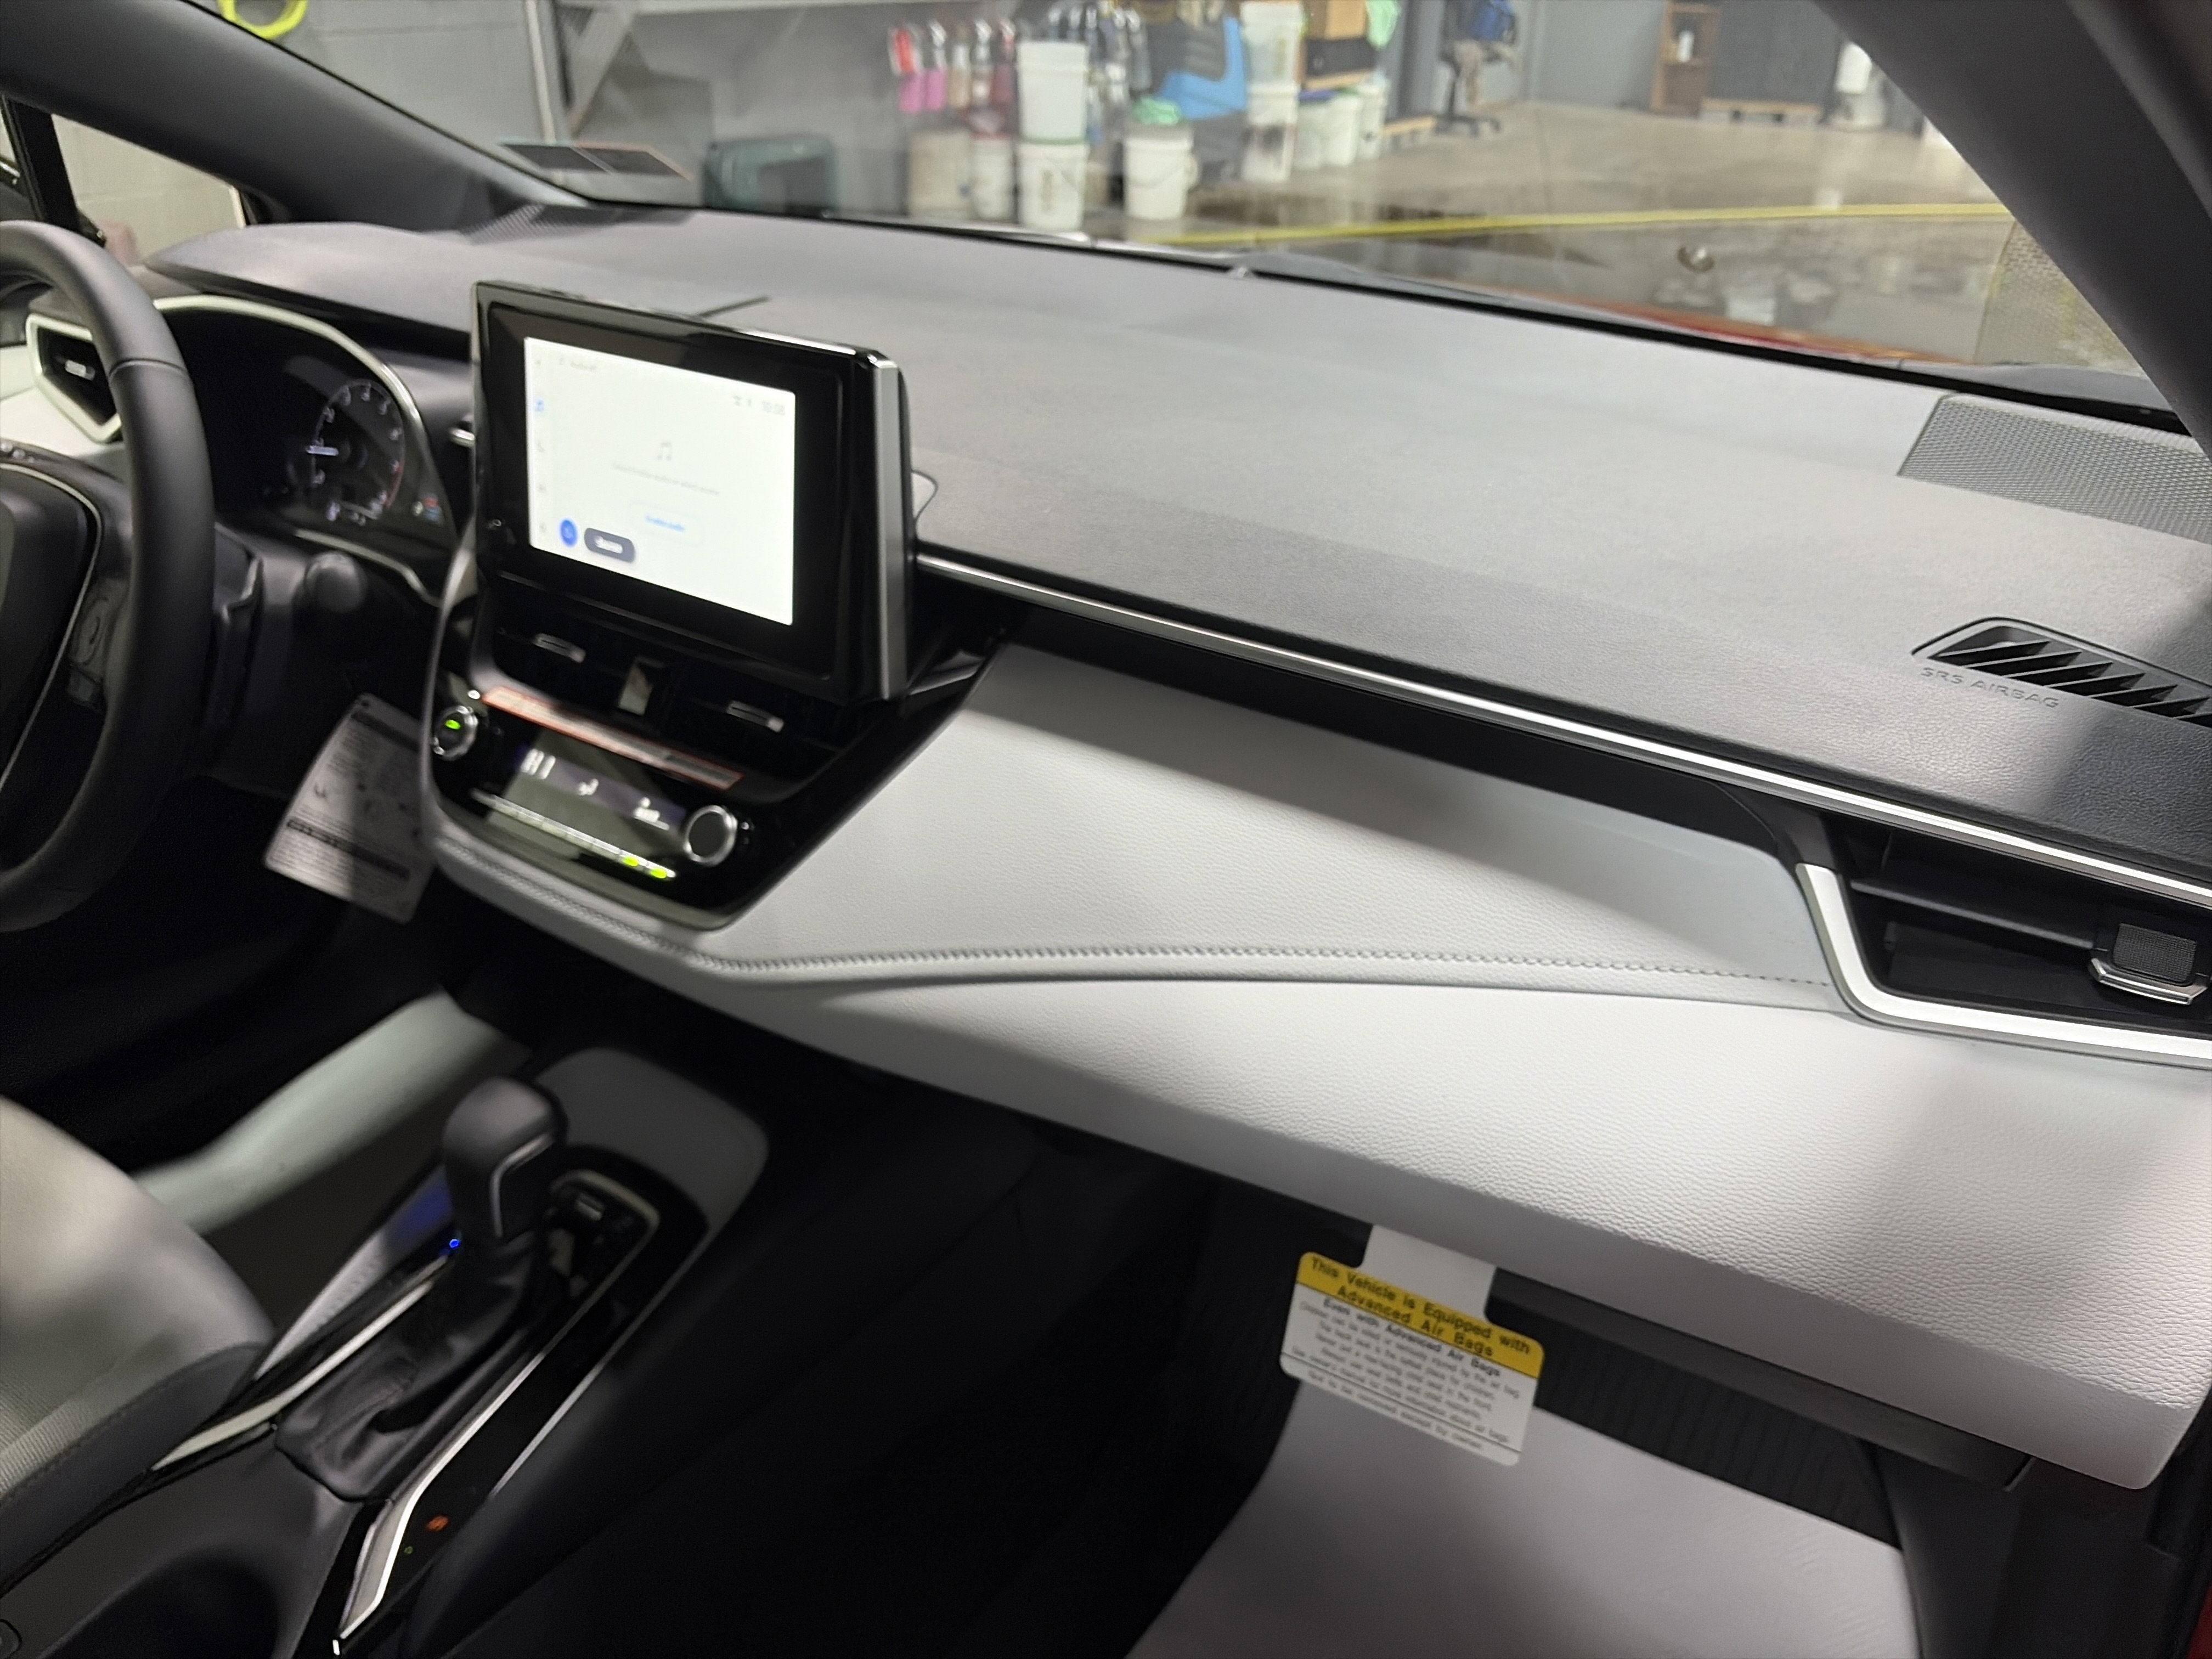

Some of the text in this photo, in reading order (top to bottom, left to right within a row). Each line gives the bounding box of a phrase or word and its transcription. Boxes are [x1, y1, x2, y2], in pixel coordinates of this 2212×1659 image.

[1921, 667, 2059, 708] SRS AIRBAG
[1312, 1255, 1530, 1355] This Vehicle is Equipped with
[1338, 1285, 1493, 1356] Advanced Air Bags
[1356, 1314, 1380, 1328] with
[1385, 1325, 1442, 1352] Advanced
[1471, 1357, 1500, 1376] Bags
